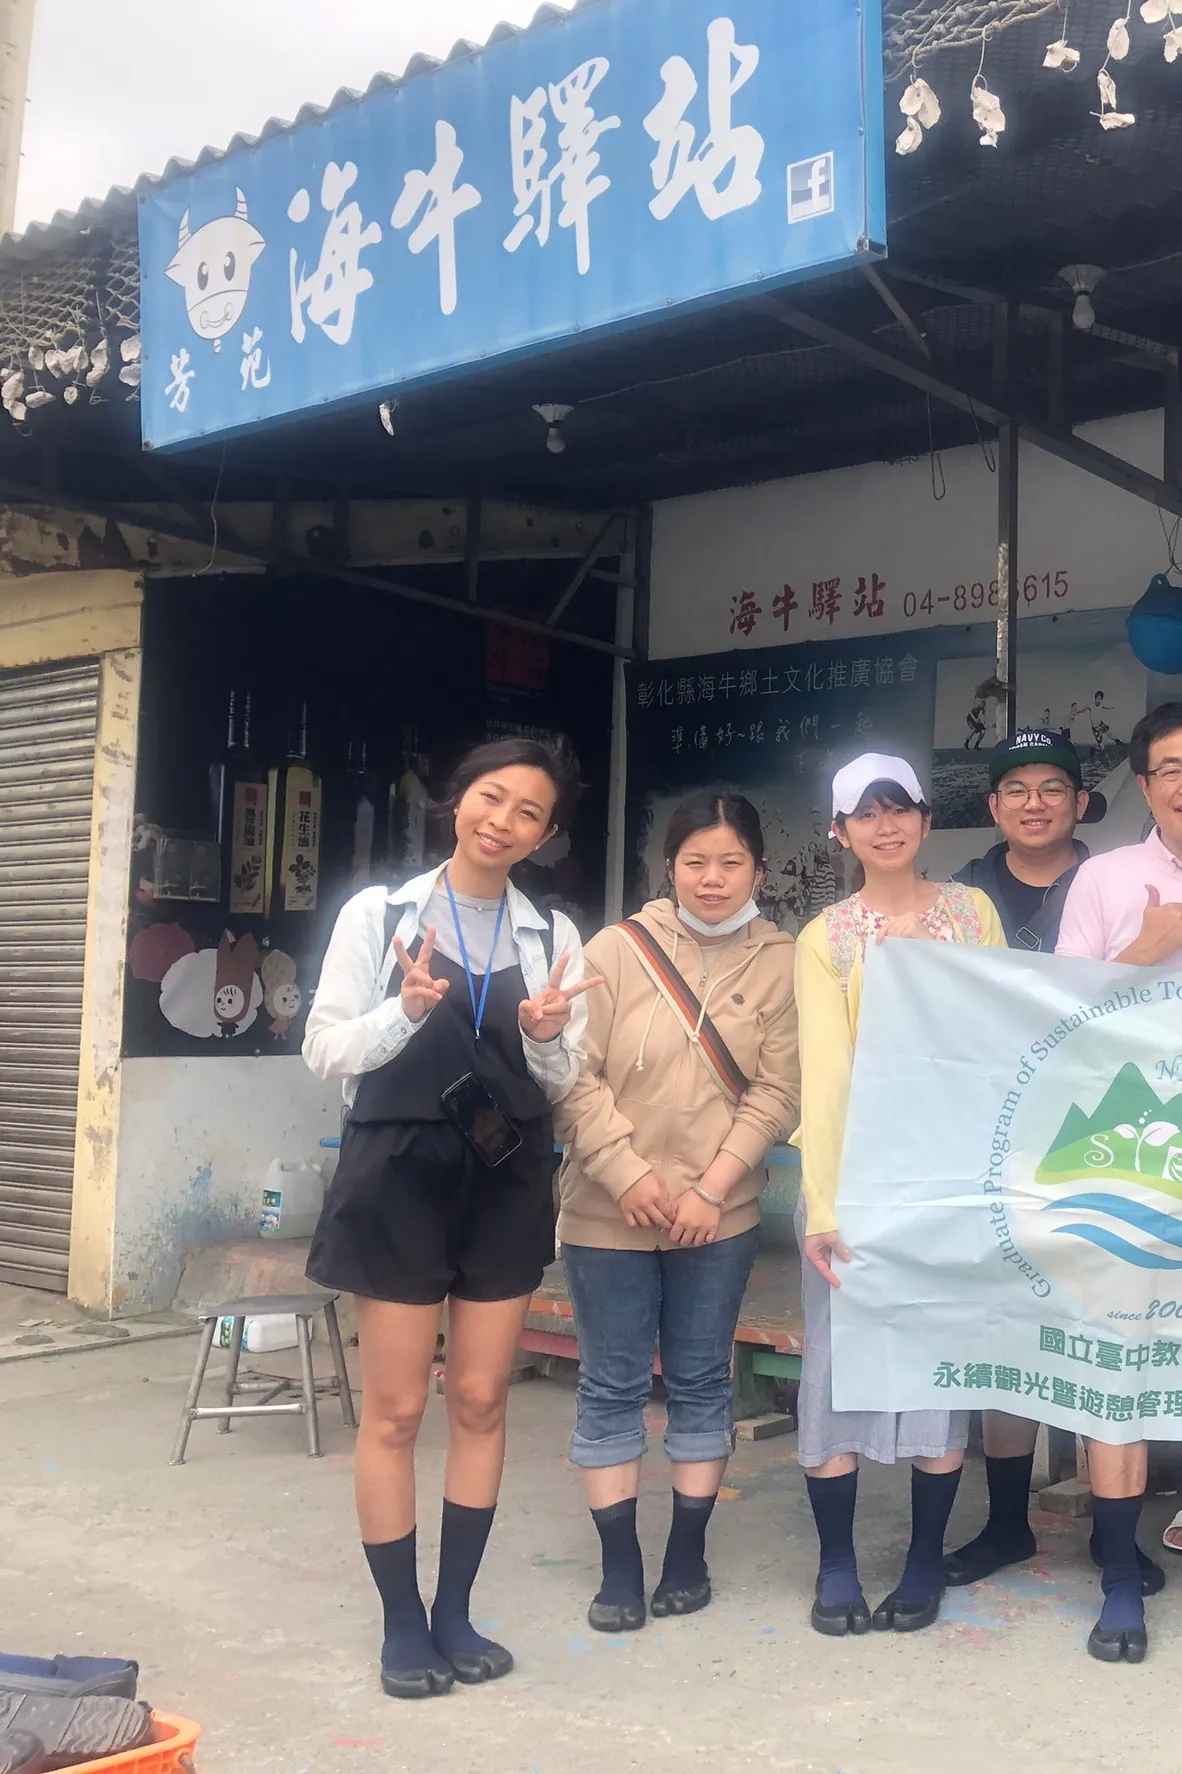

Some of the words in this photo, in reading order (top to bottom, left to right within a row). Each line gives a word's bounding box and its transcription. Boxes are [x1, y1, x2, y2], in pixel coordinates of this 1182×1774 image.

[289, 17, 764, 346] 海牛驛站
[164, 327, 271, 413] 芳苑
[728, 573, 887, 636] 海牛驛站
[903, 570, 1069, 618] 04-898615
[636, 652, 919, 709] 彰化縣海牛鄉土文化推廣協會
[1015, 733, 1040, 745] NAVY
[1030, 986, 1152, 1062] Sustainable
[1016, 1055, 1037, 1085] of
[984, 1090, 1021, 1195] Program
[990, 1201, 1051, 1298] Graduate
[1106, 1309, 1142, 1321] since
